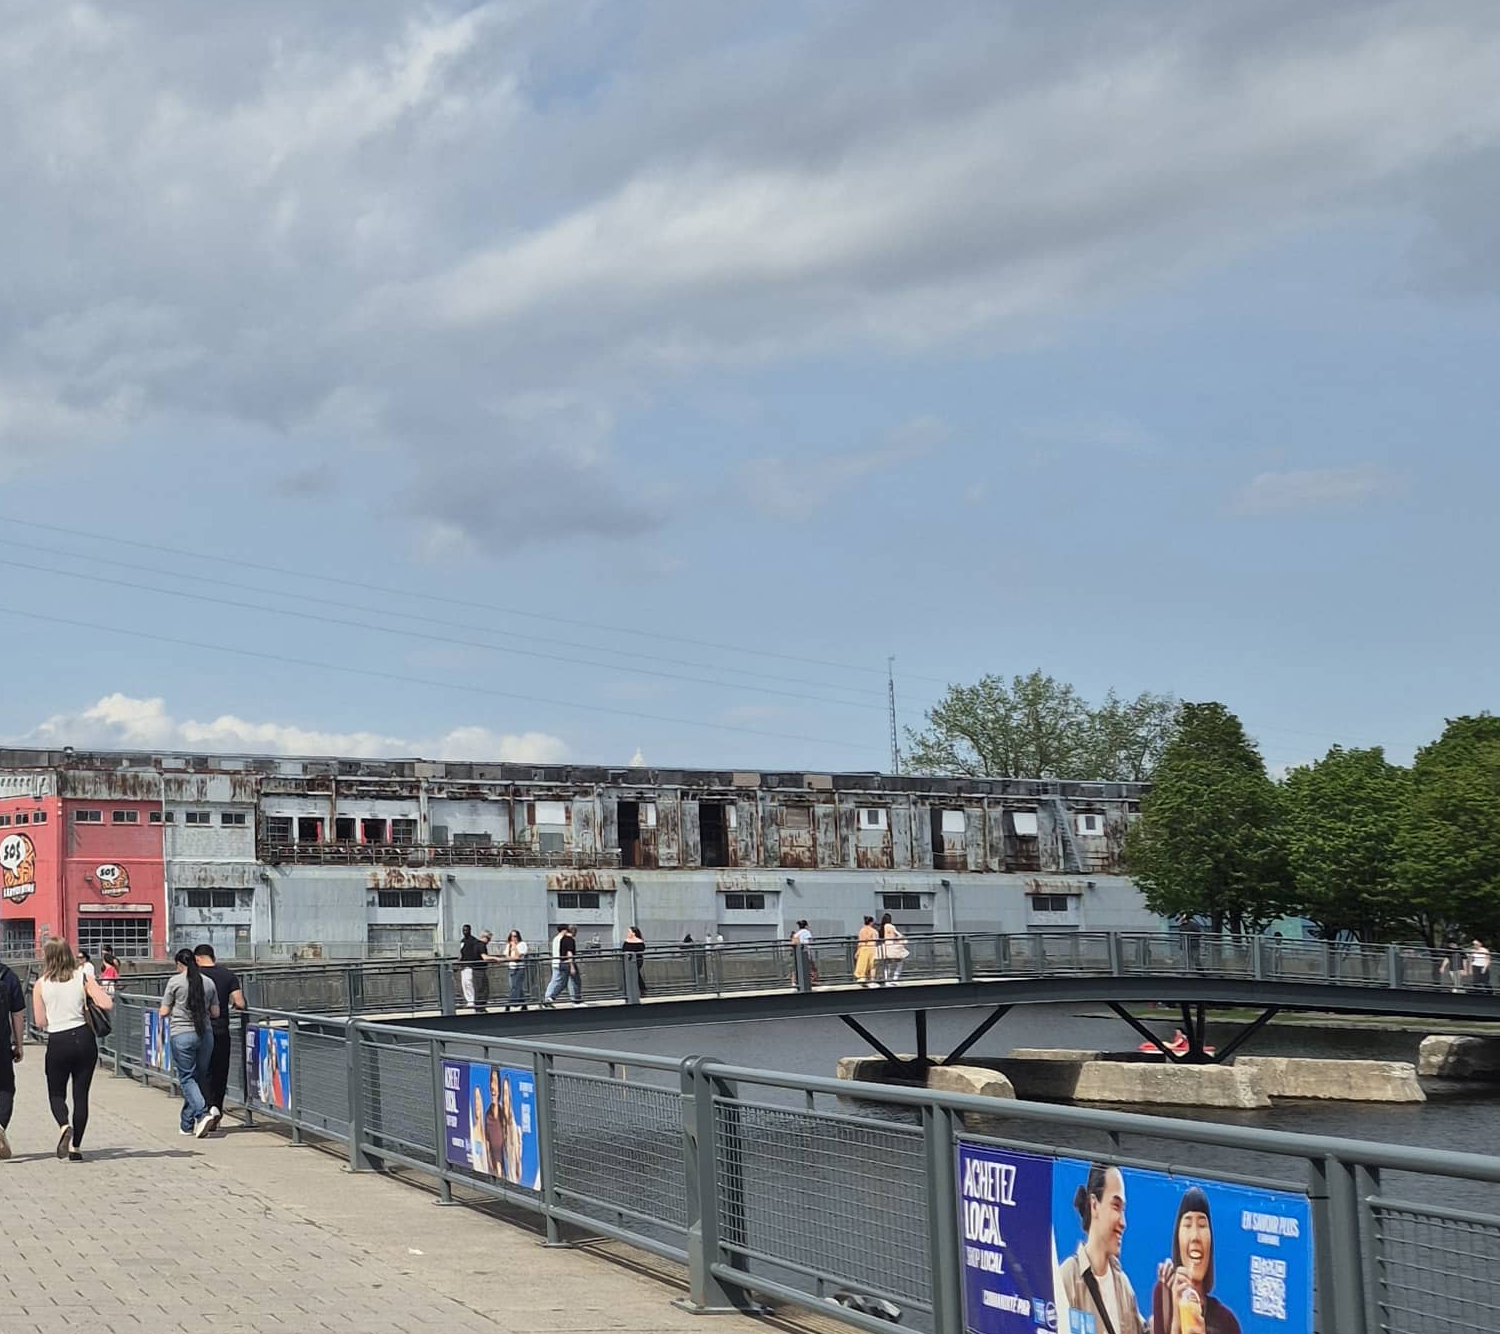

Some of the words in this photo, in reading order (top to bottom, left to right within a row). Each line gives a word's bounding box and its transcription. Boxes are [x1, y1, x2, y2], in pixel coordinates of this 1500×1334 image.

[4, 841, 21, 861] SOS
[100, 868, 116, 877] SOS
[963, 1157, 1017, 1206] ACHETEZ
[963, 1199, 1007, 1248] LOCAL
[1280, 1217, 1300, 1238] PLUS
[980, 1249, 1006, 1274] LOCAL
